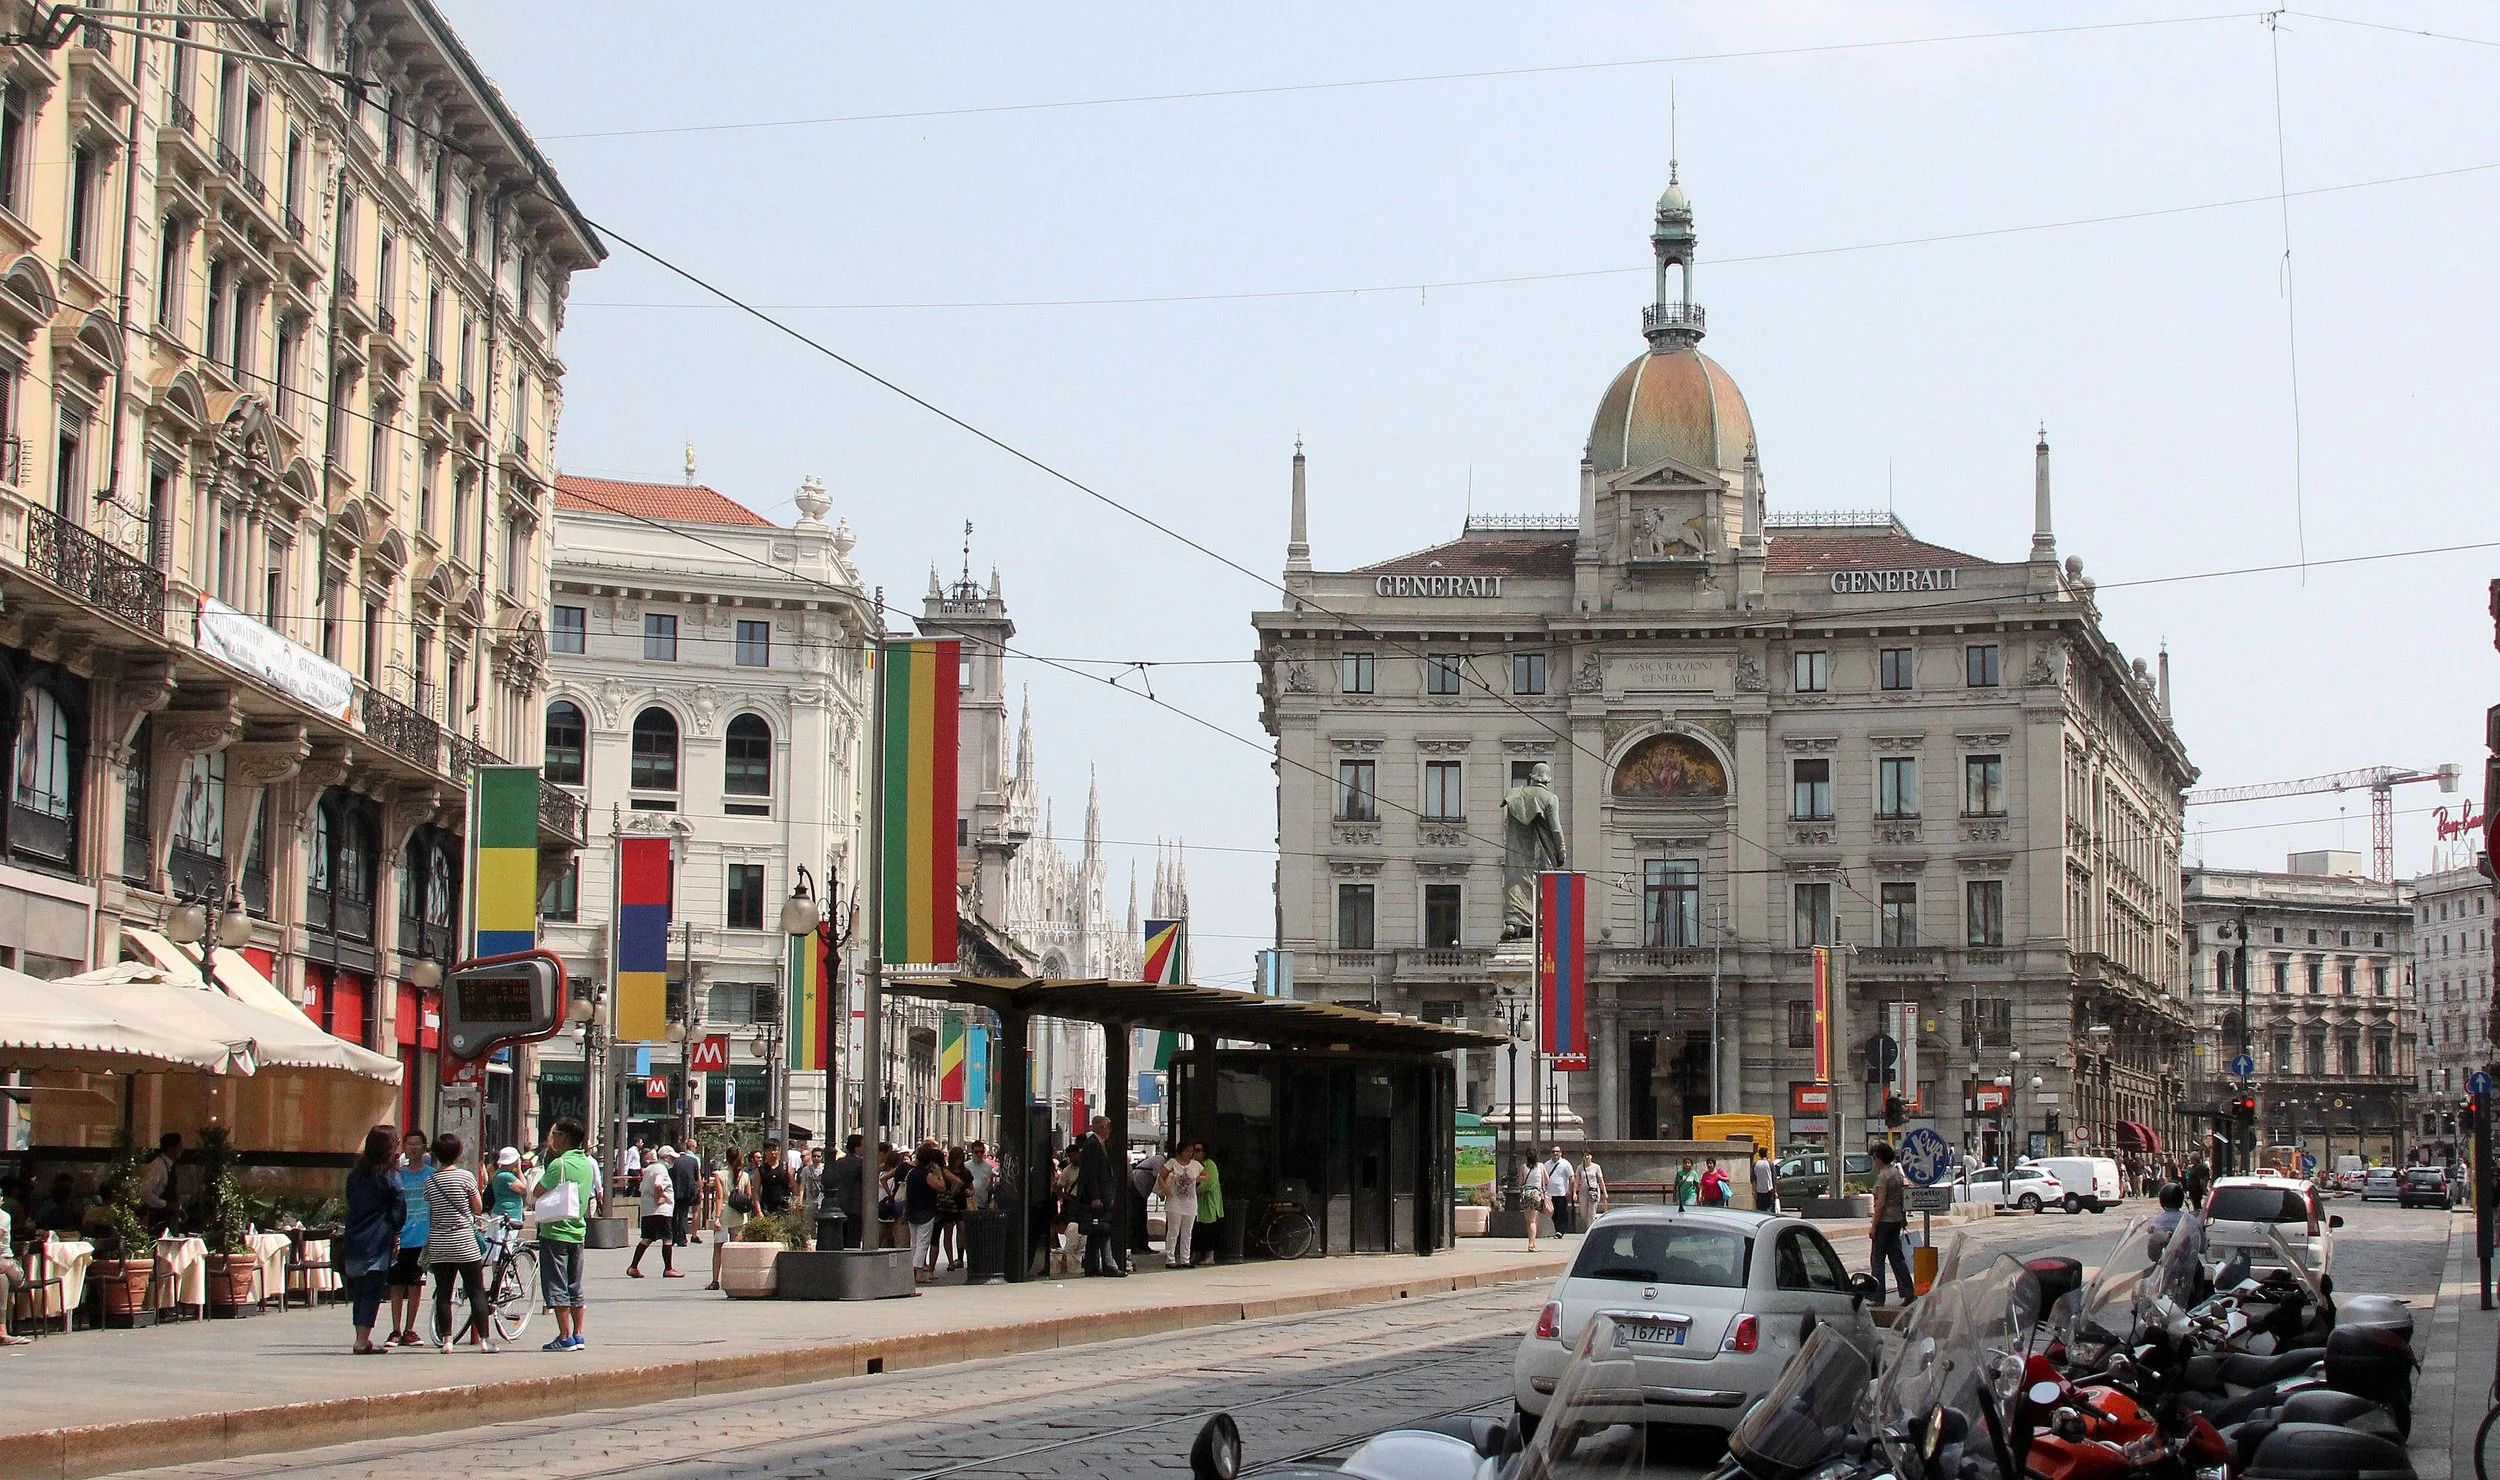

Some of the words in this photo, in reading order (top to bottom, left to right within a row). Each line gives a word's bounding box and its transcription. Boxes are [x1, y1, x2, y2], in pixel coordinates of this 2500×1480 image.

[1375, 575, 1503, 598] GENERALI
[1830, 567, 1958, 593] GENERALI
[1641, 673, 1697, 684] GENERALI
[694, 1042, 723, 1063] M
[648, 1080, 667, 1093] M
[1911, 1189, 1940, 1197] eccetto
